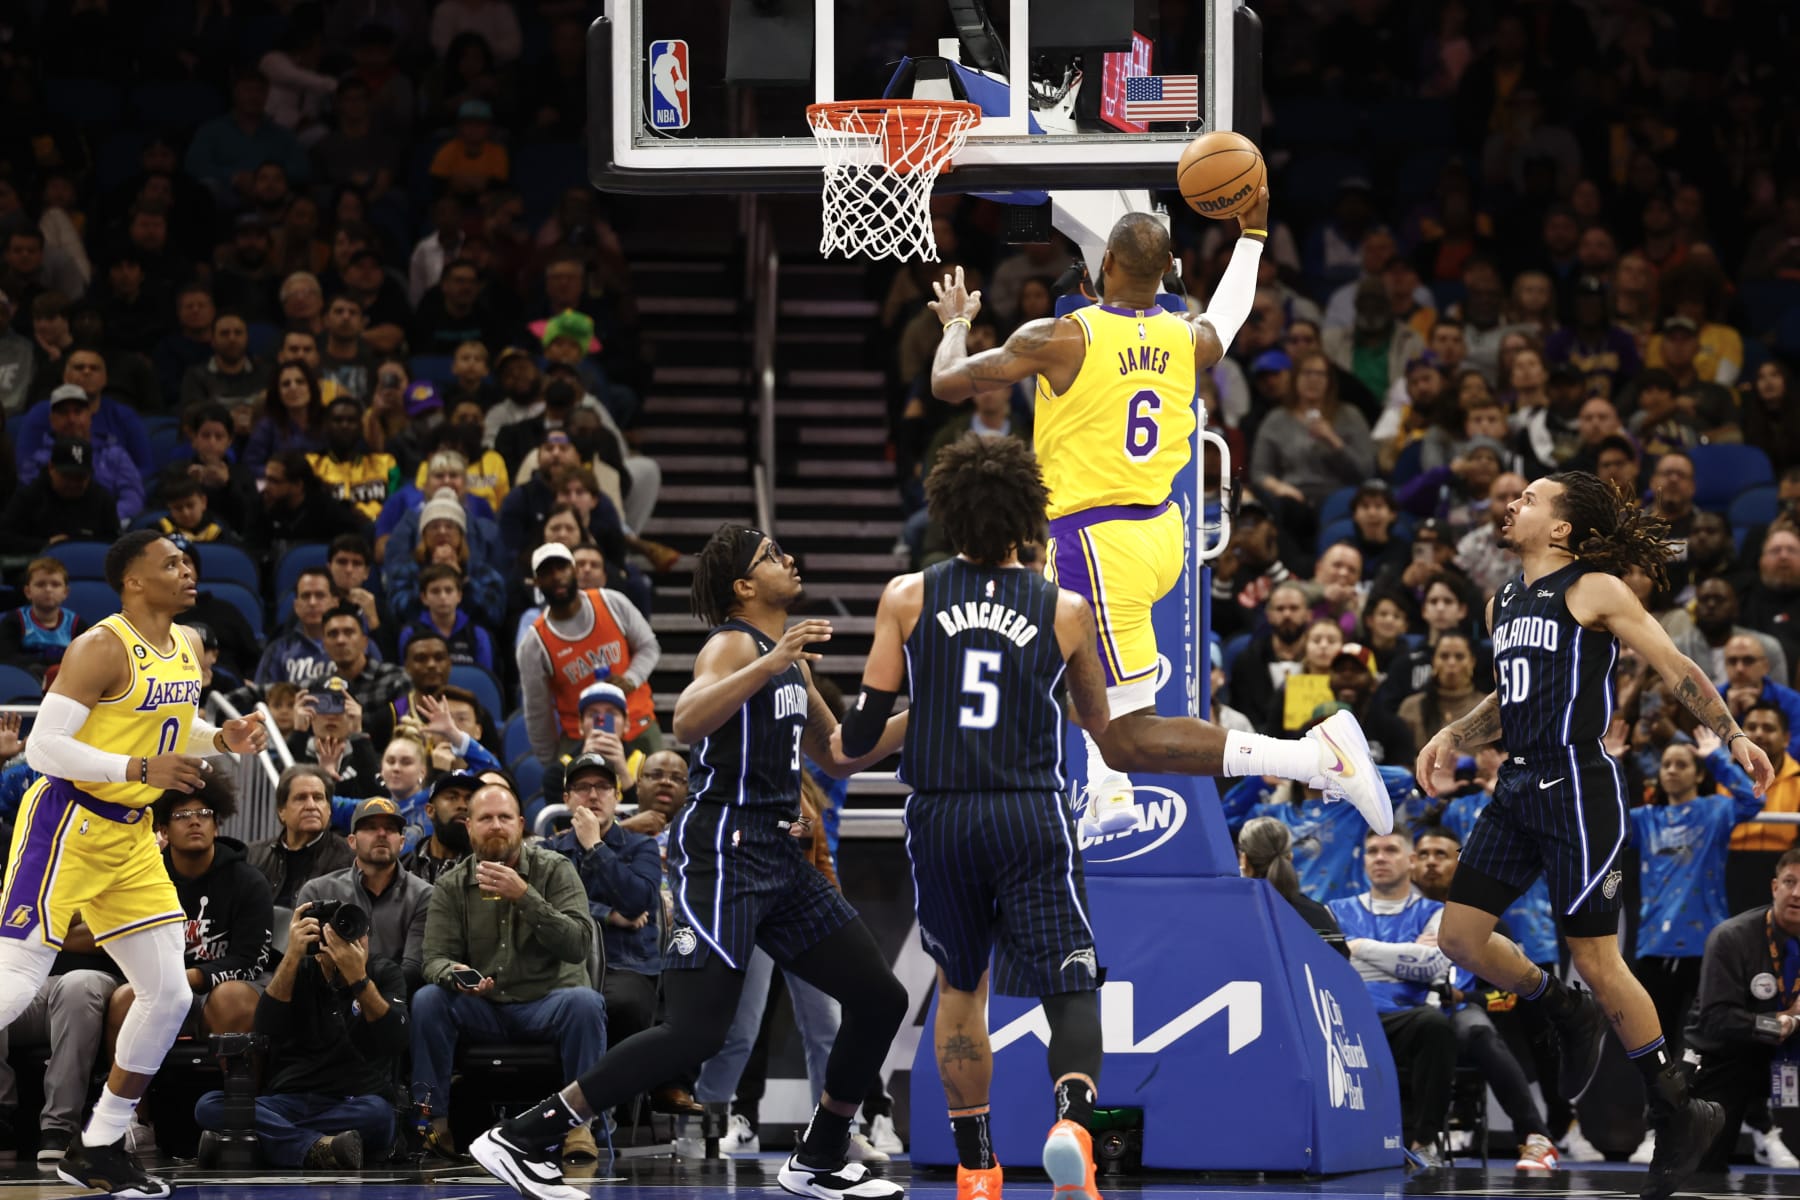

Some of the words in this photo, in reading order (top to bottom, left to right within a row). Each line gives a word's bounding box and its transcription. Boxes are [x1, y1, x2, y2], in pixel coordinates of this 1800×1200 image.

[657, 109, 675, 124] NBA
[1195, 183, 1253, 212] Wilson
[1117, 345, 1170, 376] JAMES
[1124, 388, 1162, 460] 6
[935, 601, 1038, 648] BANCHERO
[134, 645, 145, 658] 6
[562, 640, 622, 685] FAMU
[135, 677, 201, 712] LAKERS
[957, 647, 1003, 730] 5
[1498, 655, 1531, 707] 50
